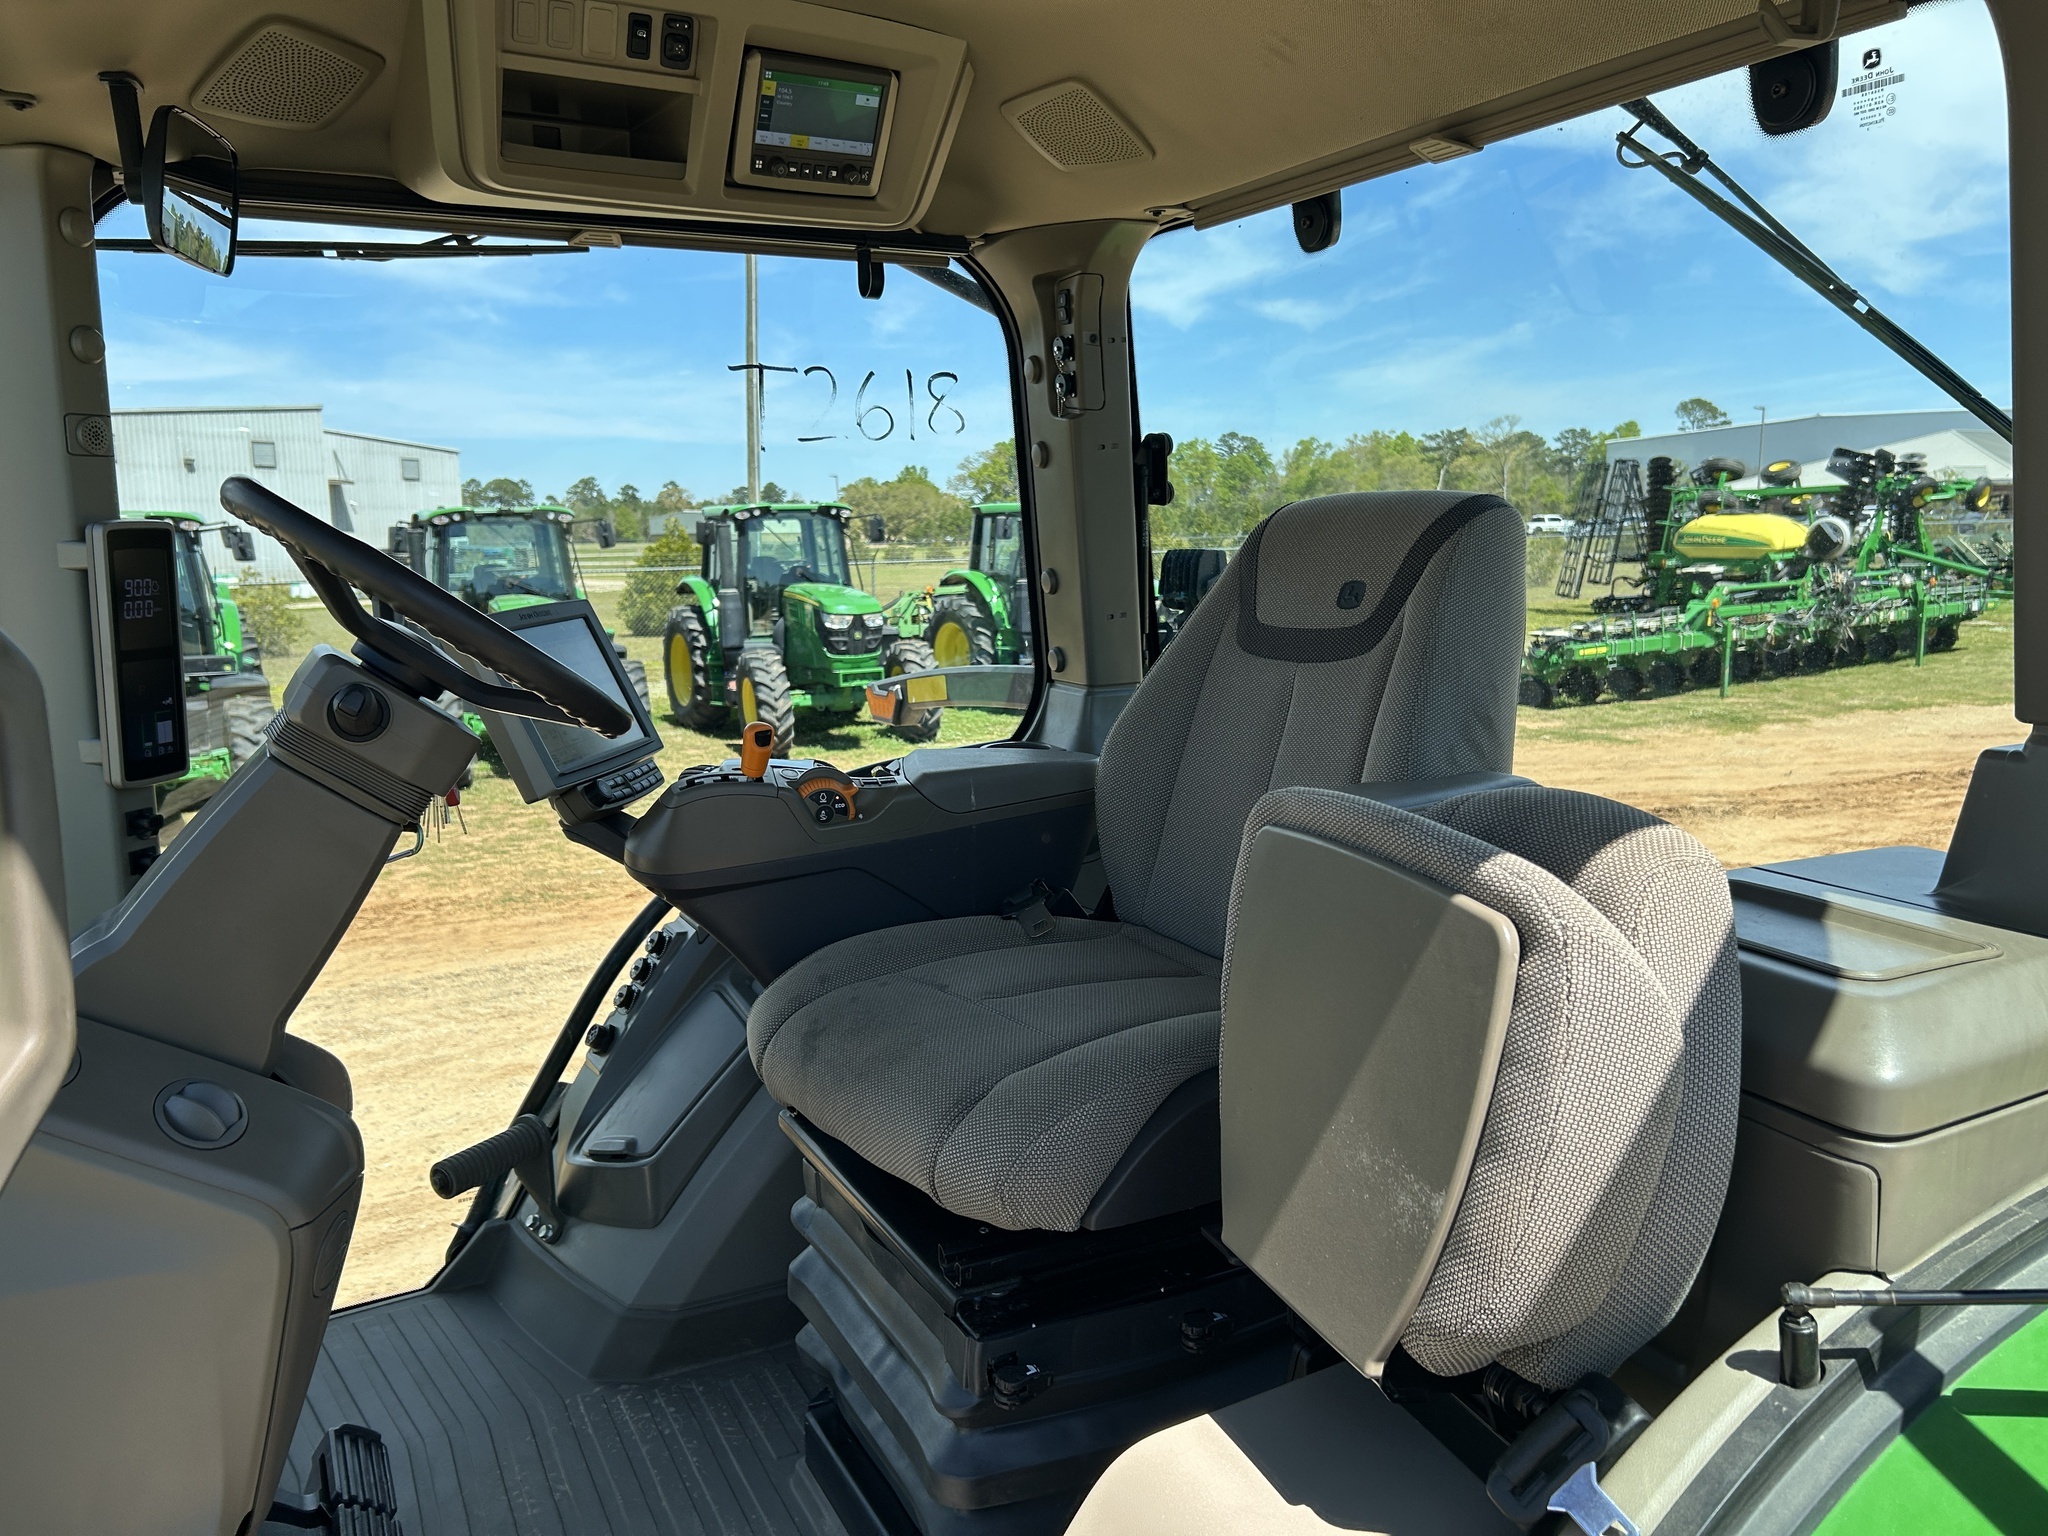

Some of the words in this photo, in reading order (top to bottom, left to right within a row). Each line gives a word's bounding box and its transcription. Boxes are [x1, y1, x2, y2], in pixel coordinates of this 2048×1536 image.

[1702, 536, 1726, 545] DEERE
[124, 578, 151, 597] 900
[123, 600, 153, 619] 0.00
